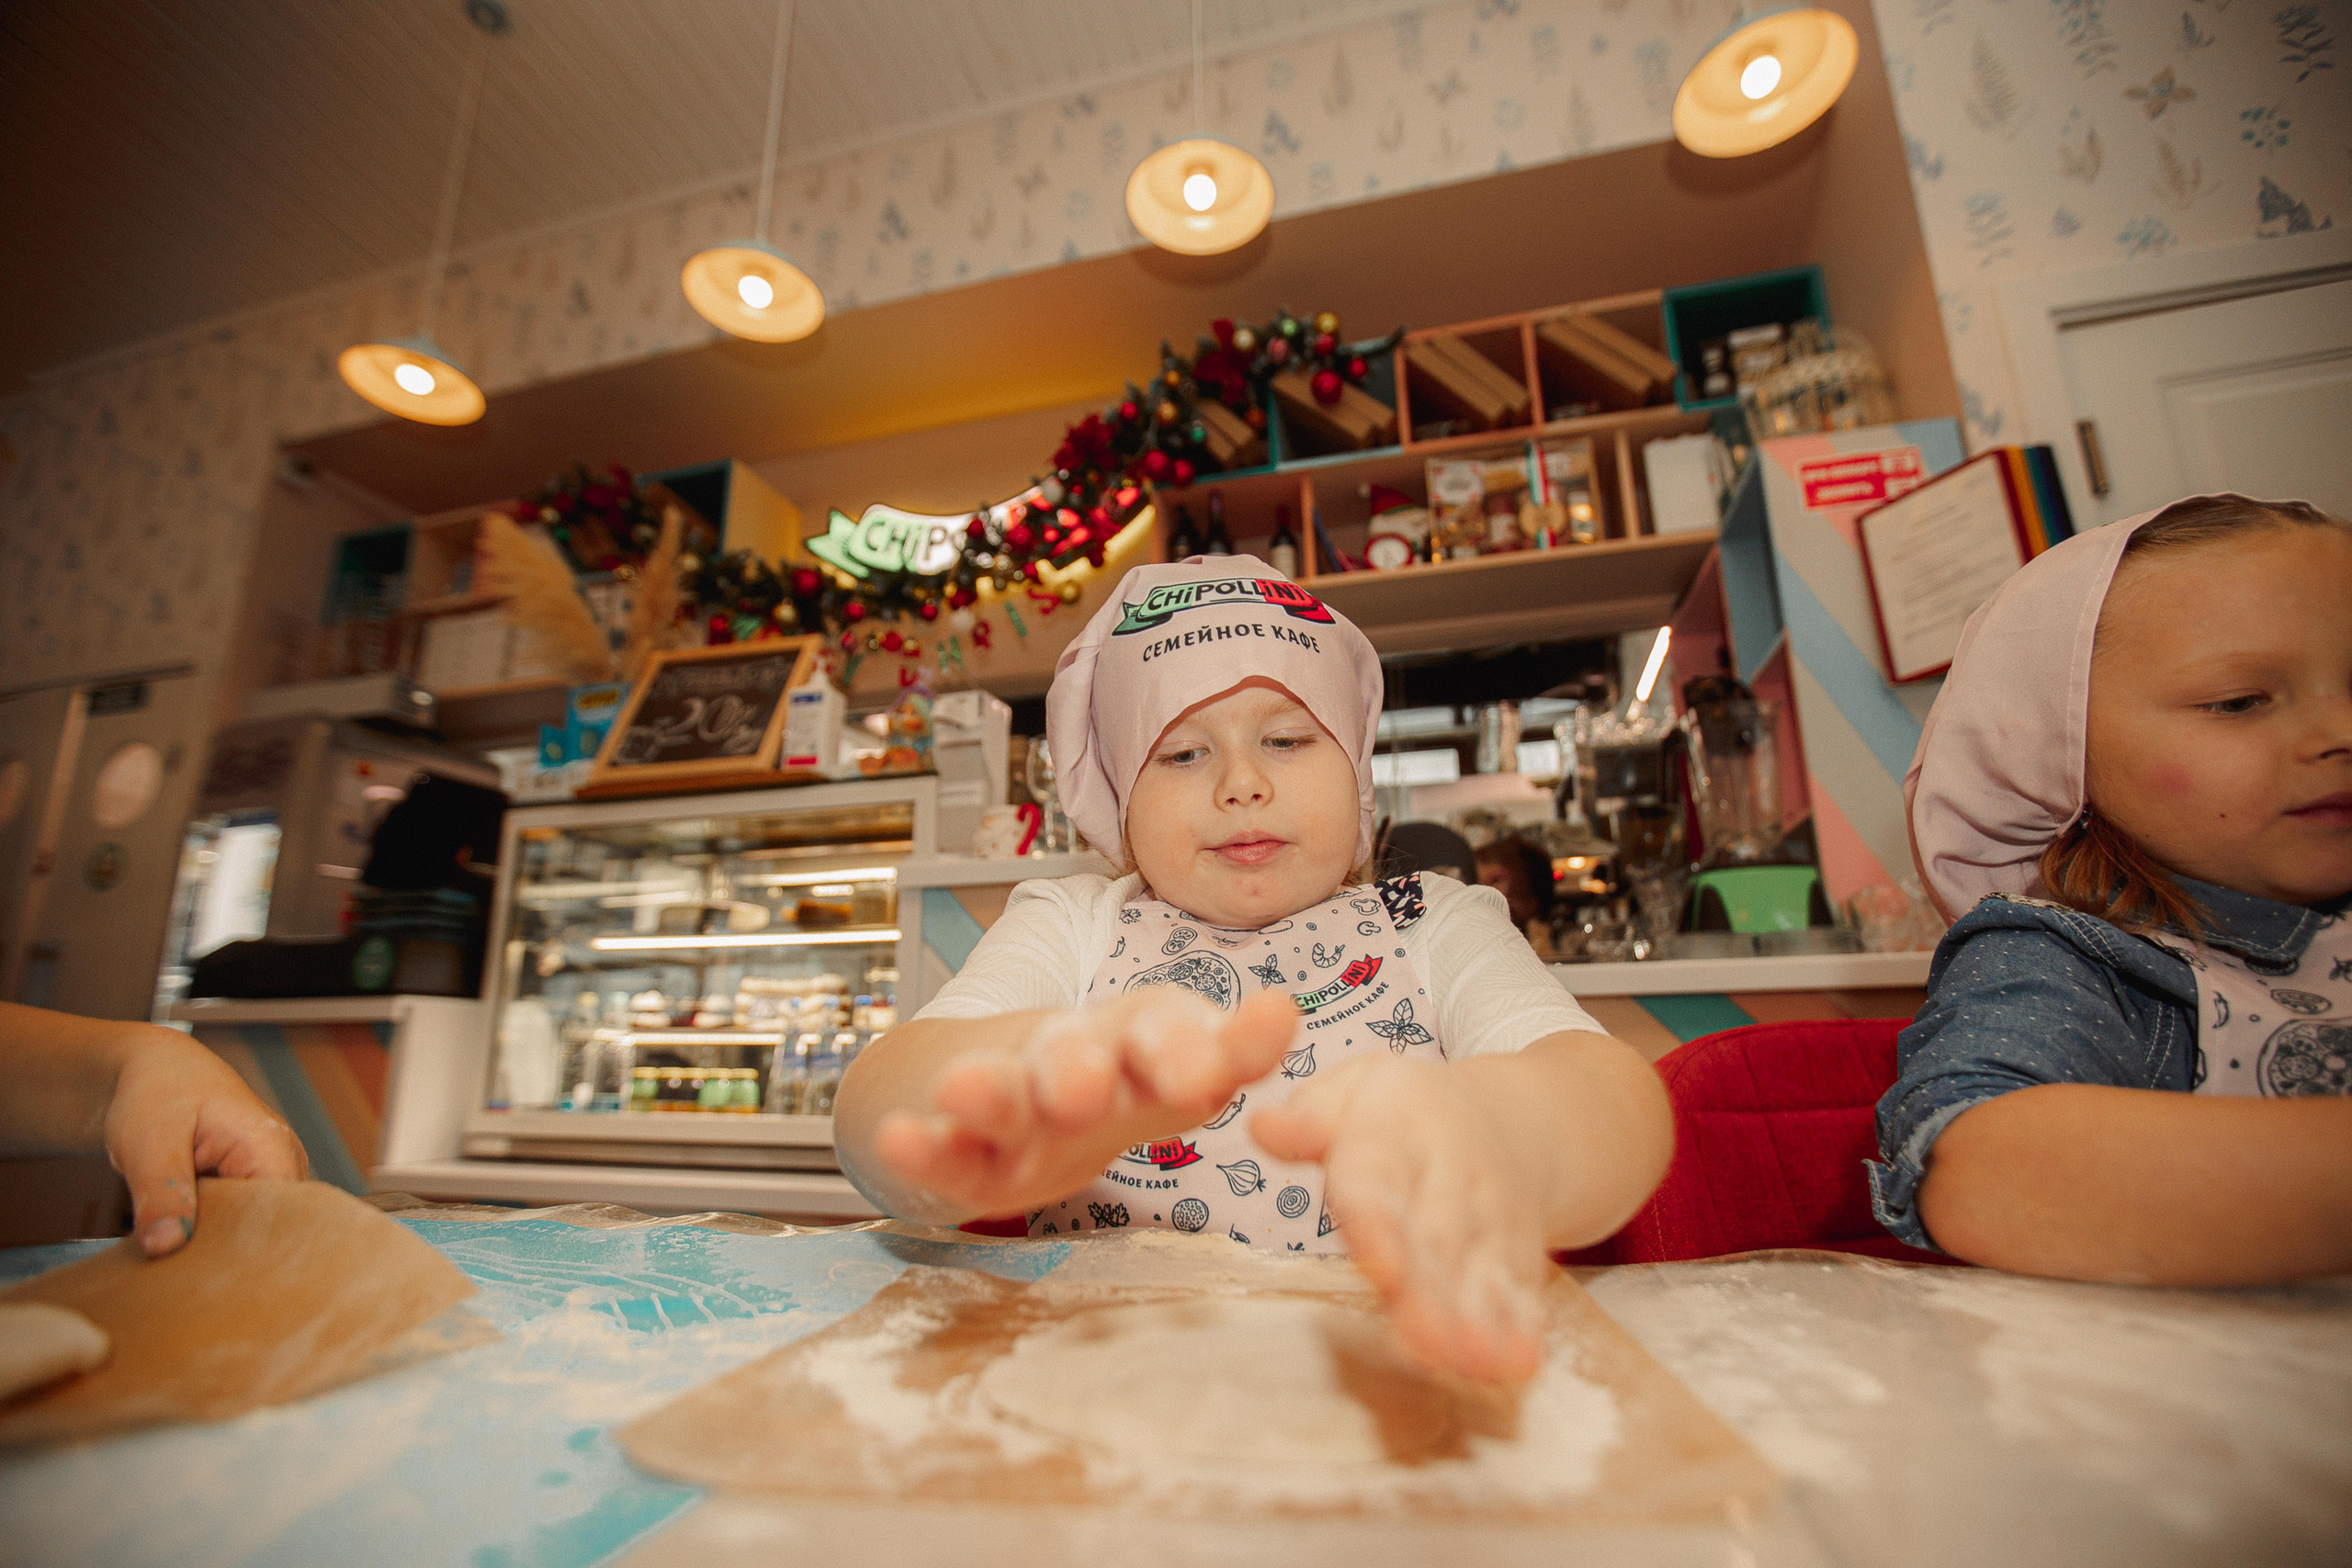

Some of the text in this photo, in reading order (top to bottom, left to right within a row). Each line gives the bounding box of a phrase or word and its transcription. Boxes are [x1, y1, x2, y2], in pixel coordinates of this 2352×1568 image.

[1142, 624, 1321, 662] СЕМЕЙНОЕ КАФЕ
[1306, 981, 1390, 1031] СЕМЕЙНОЕ КАФЕ
[1128, 1141, 1180, 1160] OLLiNi
[1102, 1168, 1180, 1190] ЕЙНОЕ КАФЕ
